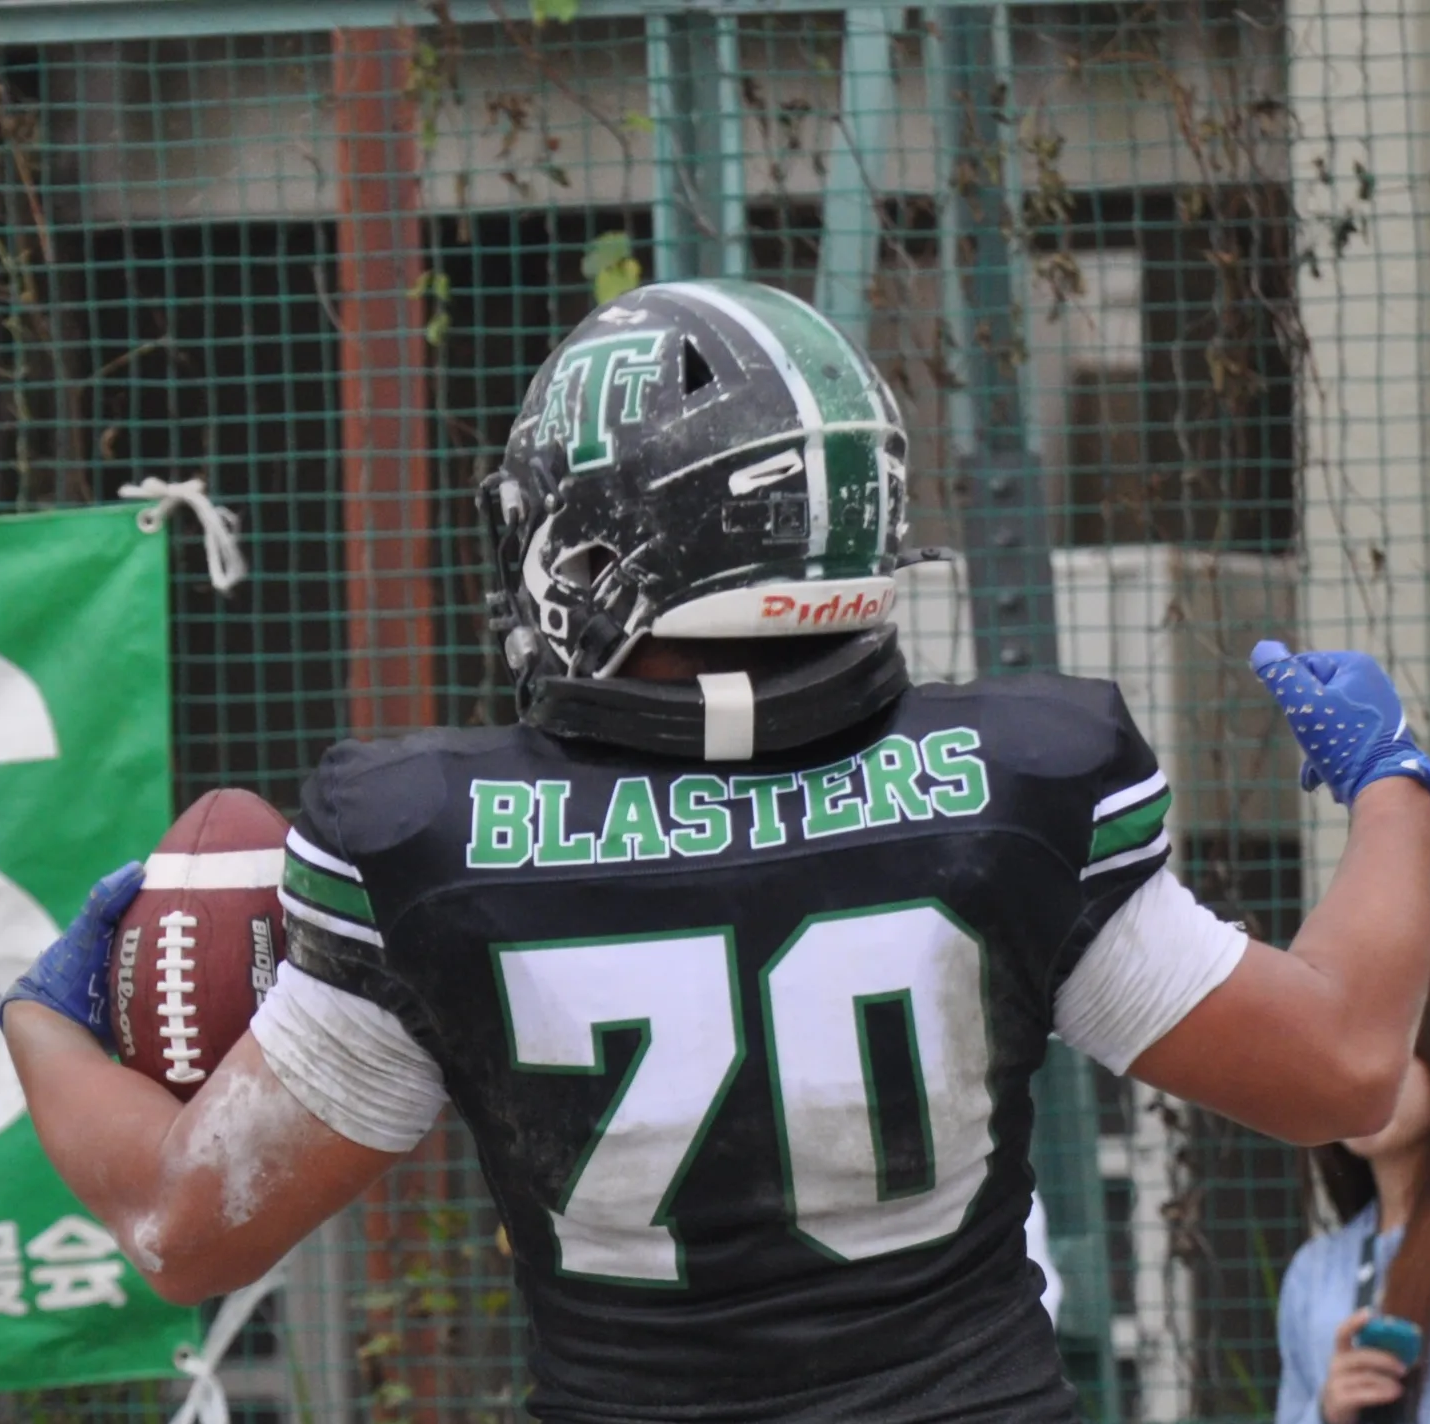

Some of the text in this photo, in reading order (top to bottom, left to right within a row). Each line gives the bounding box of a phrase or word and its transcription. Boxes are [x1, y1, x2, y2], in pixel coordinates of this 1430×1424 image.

[467, 727, 990, 868] BLASTERS
[117, 926, 142, 1057] Wilson
[489, 897, 999, 1289] 70
